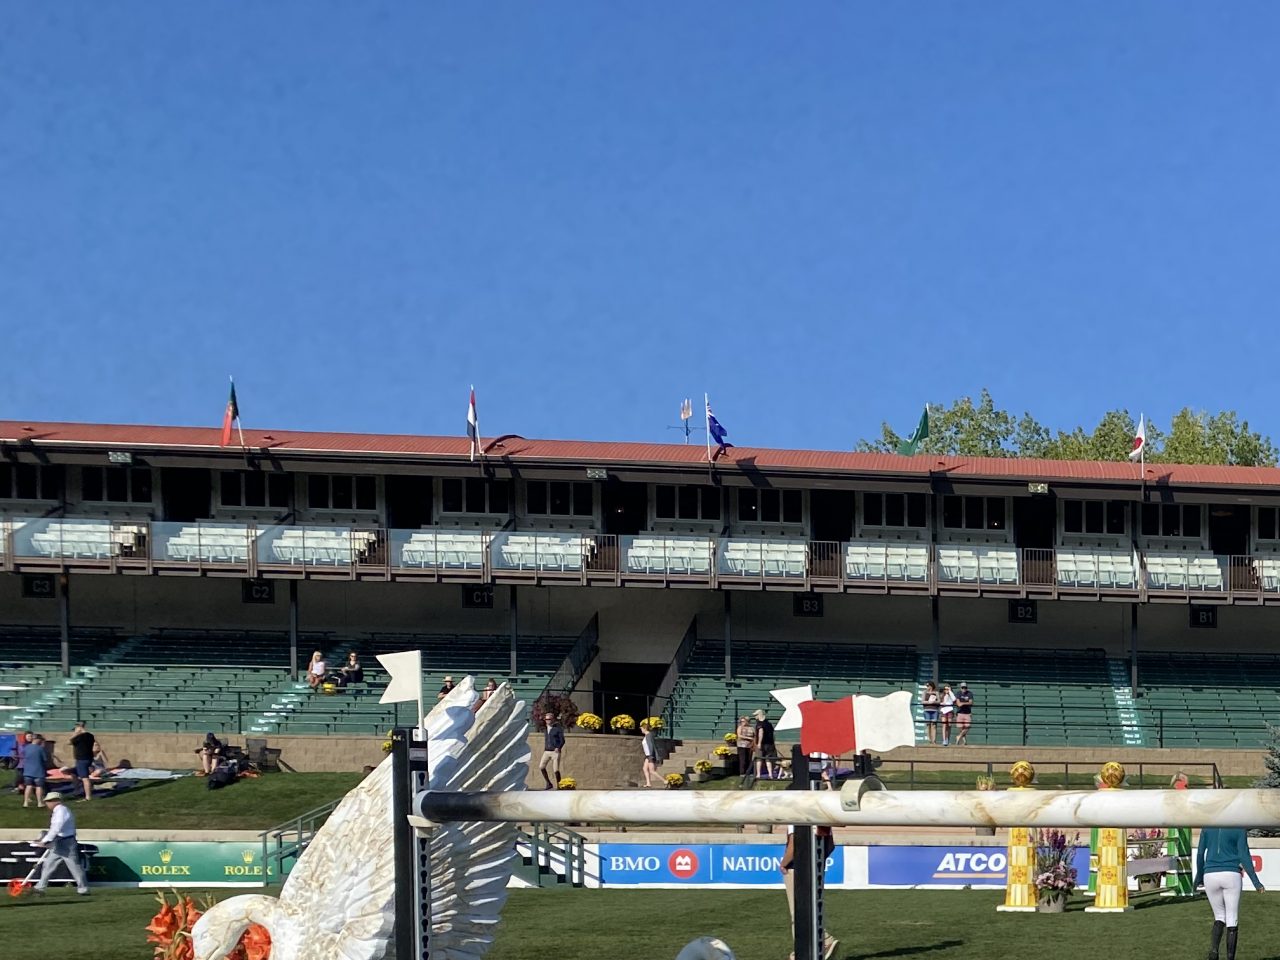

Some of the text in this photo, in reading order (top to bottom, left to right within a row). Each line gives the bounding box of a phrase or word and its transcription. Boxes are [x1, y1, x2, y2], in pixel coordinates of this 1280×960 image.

[32, 580, 50, 593] C3
[252, 586, 269, 598] C2
[802, 600, 819, 612] B3
[1017, 606, 1033, 618] B2
[1200, 611, 1214, 623] B1
[610, 856, 660, 872] BMO
[723, 856, 782, 872] NATION
[937, 853, 1006, 872] ATCO
[141, 865, 190, 875] ROLEX
